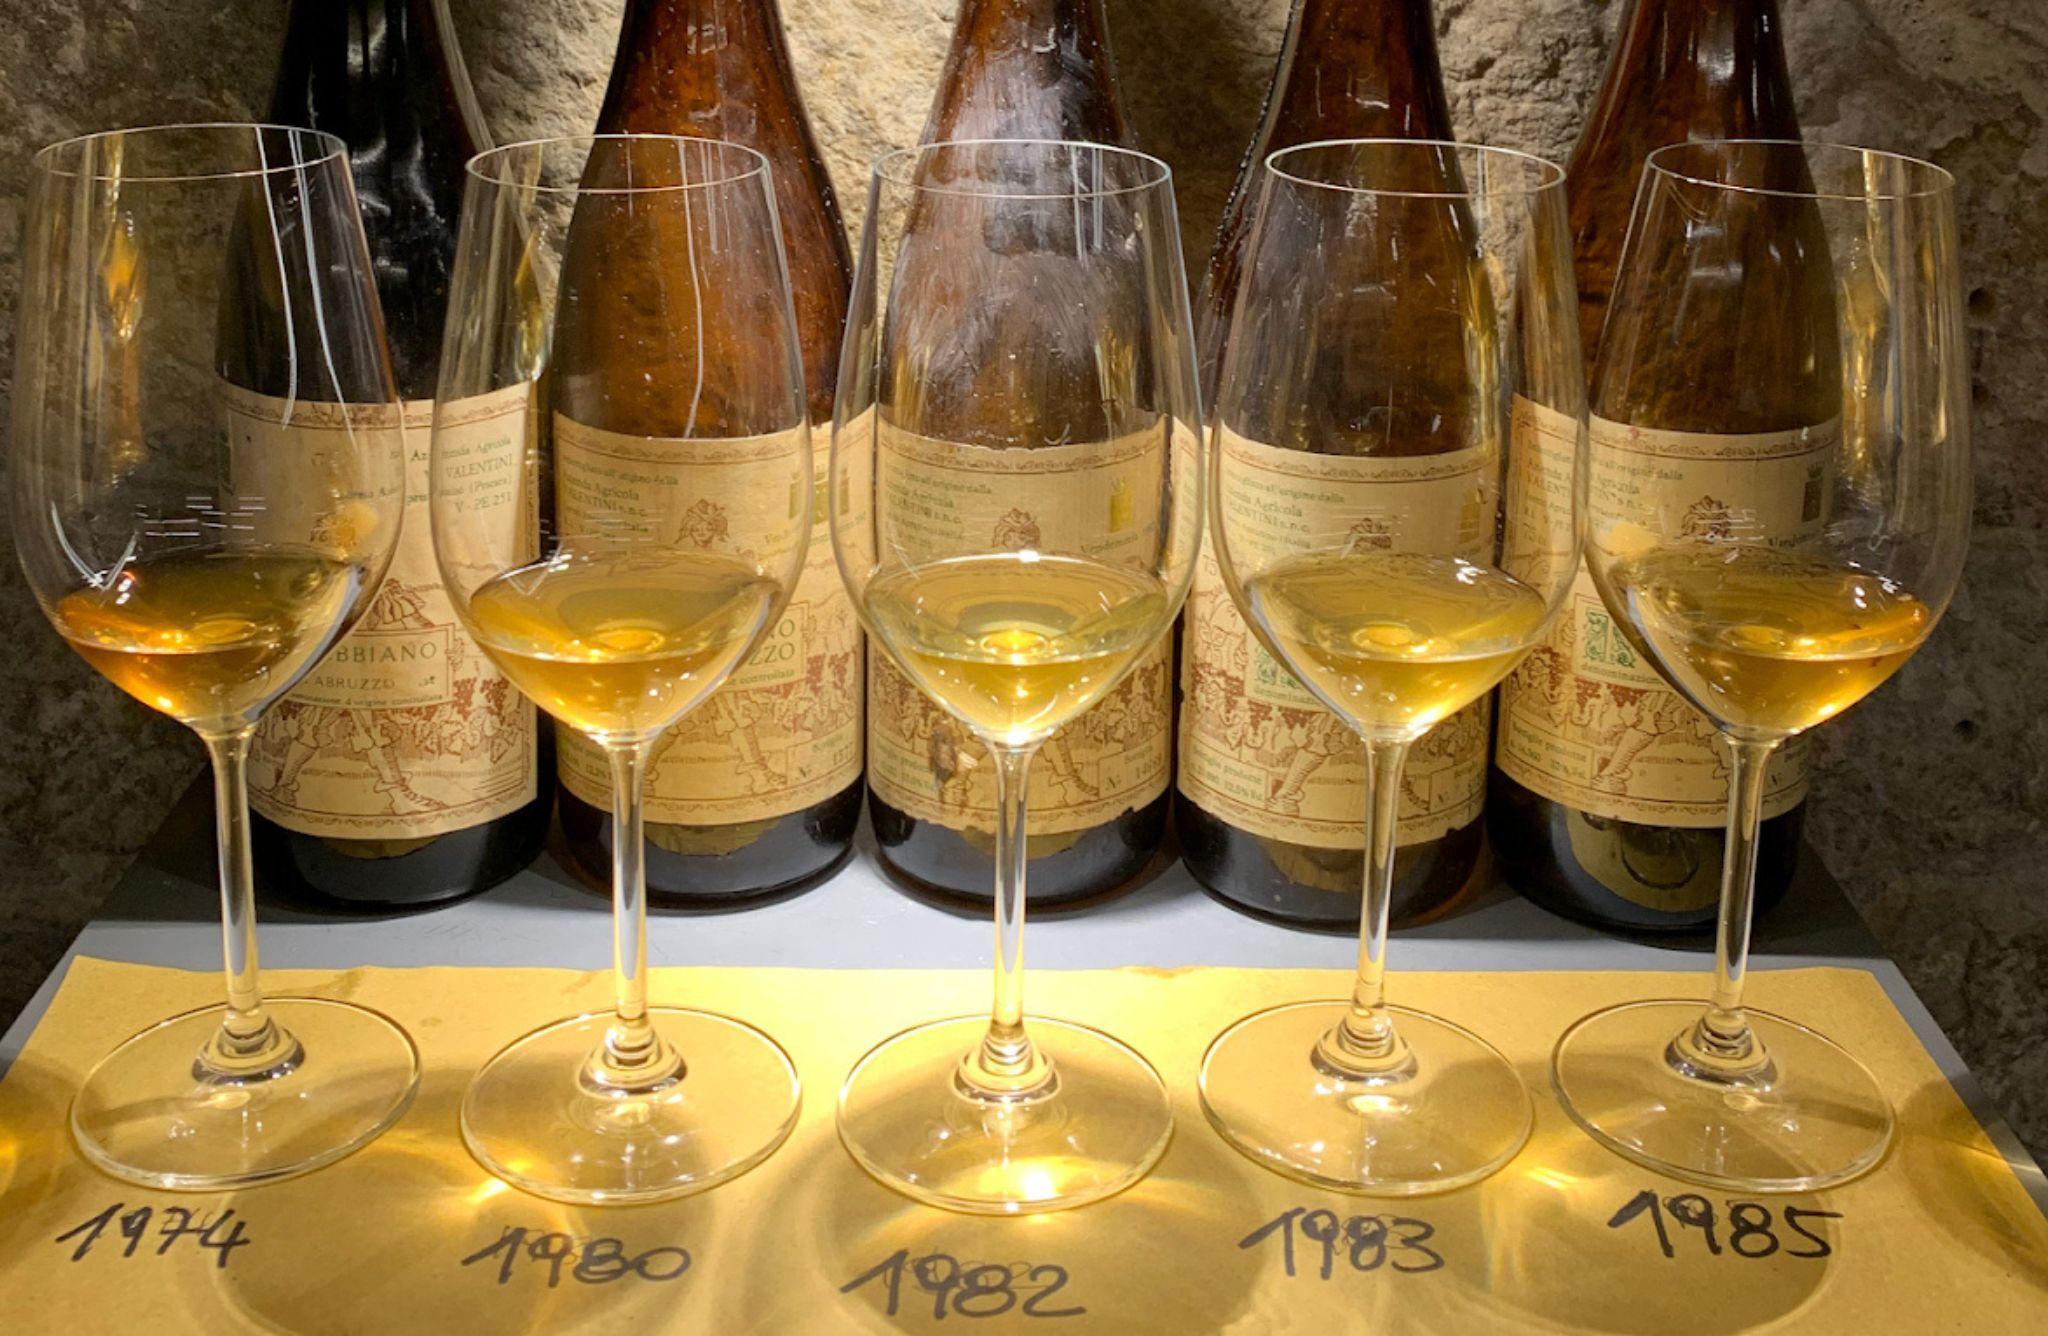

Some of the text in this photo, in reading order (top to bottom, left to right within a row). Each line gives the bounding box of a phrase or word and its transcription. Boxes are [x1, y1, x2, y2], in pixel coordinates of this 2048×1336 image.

[314, 675, 396, 691] ABRUZZO
[335, 641, 437, 664] BBIANO
[55, 1203, 251, 1269] 1974
[1238, 1206, 1445, 1280] 1983
[1607, 1190, 1844, 1258] 1985
[461, 1227, 691, 1288] 1980
[840, 1249, 1087, 1320] 1982
